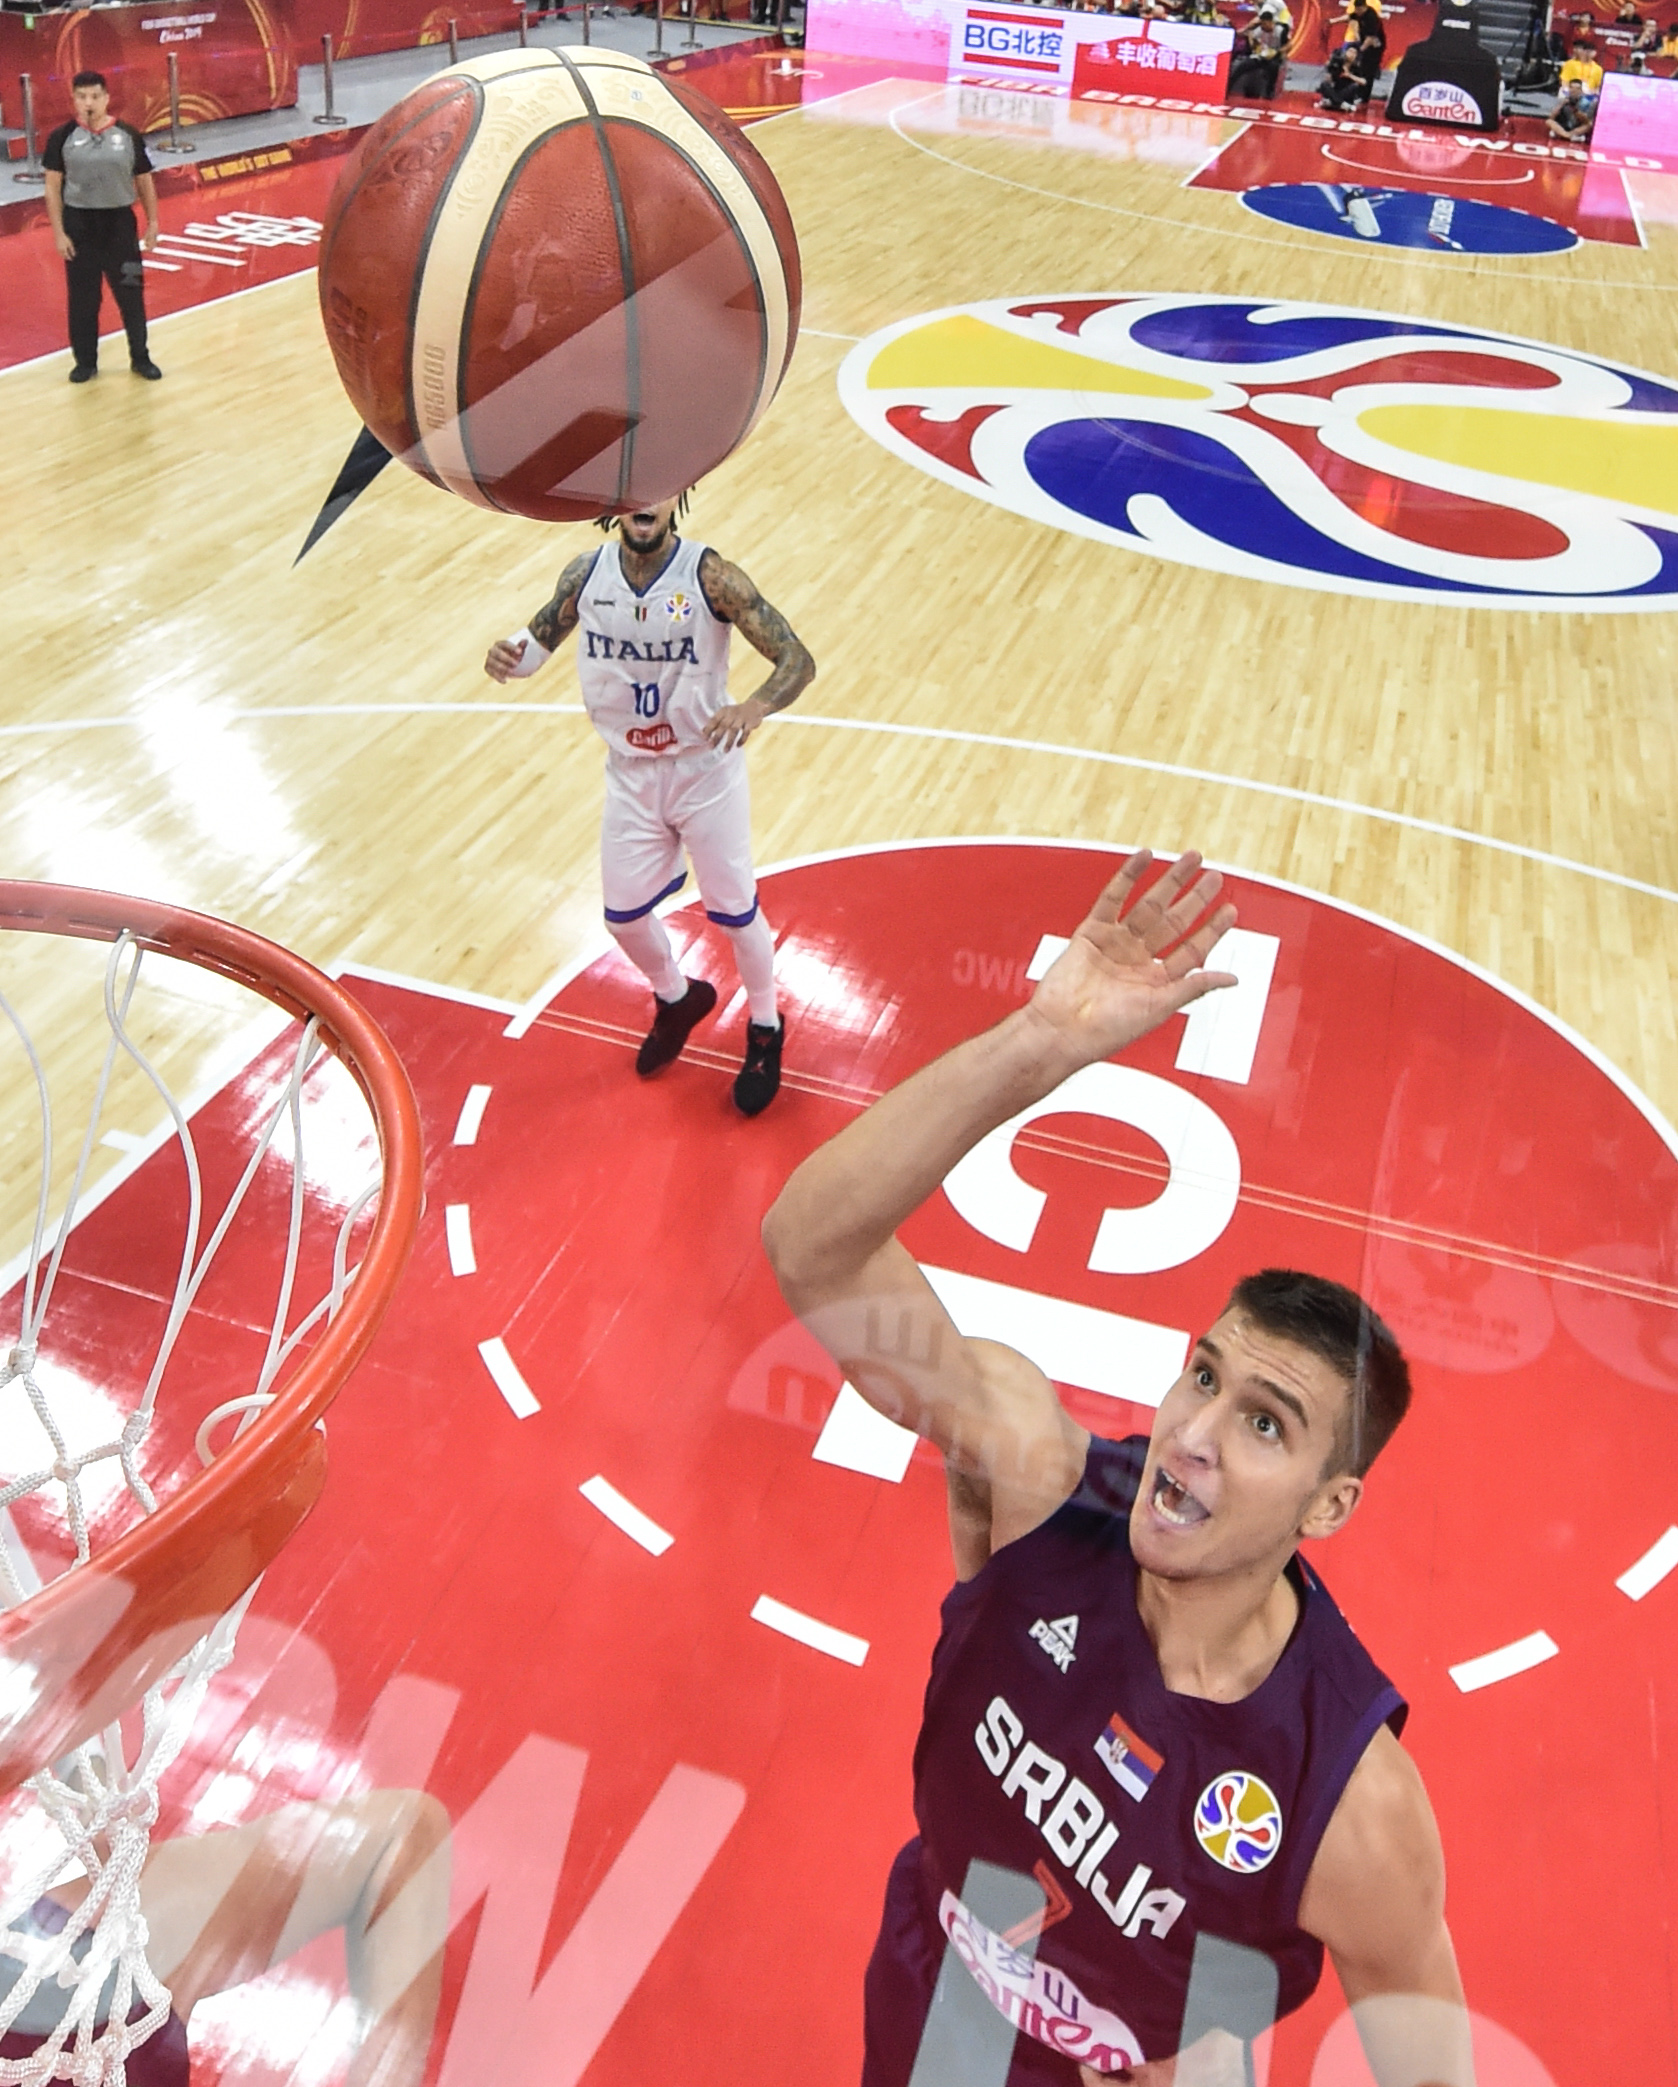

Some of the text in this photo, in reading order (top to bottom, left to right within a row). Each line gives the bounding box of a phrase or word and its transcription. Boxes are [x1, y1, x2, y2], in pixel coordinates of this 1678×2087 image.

[964, 23, 1063, 58] BG北控
[1080, 90, 1436, 142] BASKETBALL
[1455, 135, 1662, 169] WORLD
[586, 630, 699, 665] ITALIA
[630, 682, 660, 718] 10
[1027, 1617, 1076, 1675] PEAK
[974, 1695, 1186, 1940] SRBIJA
